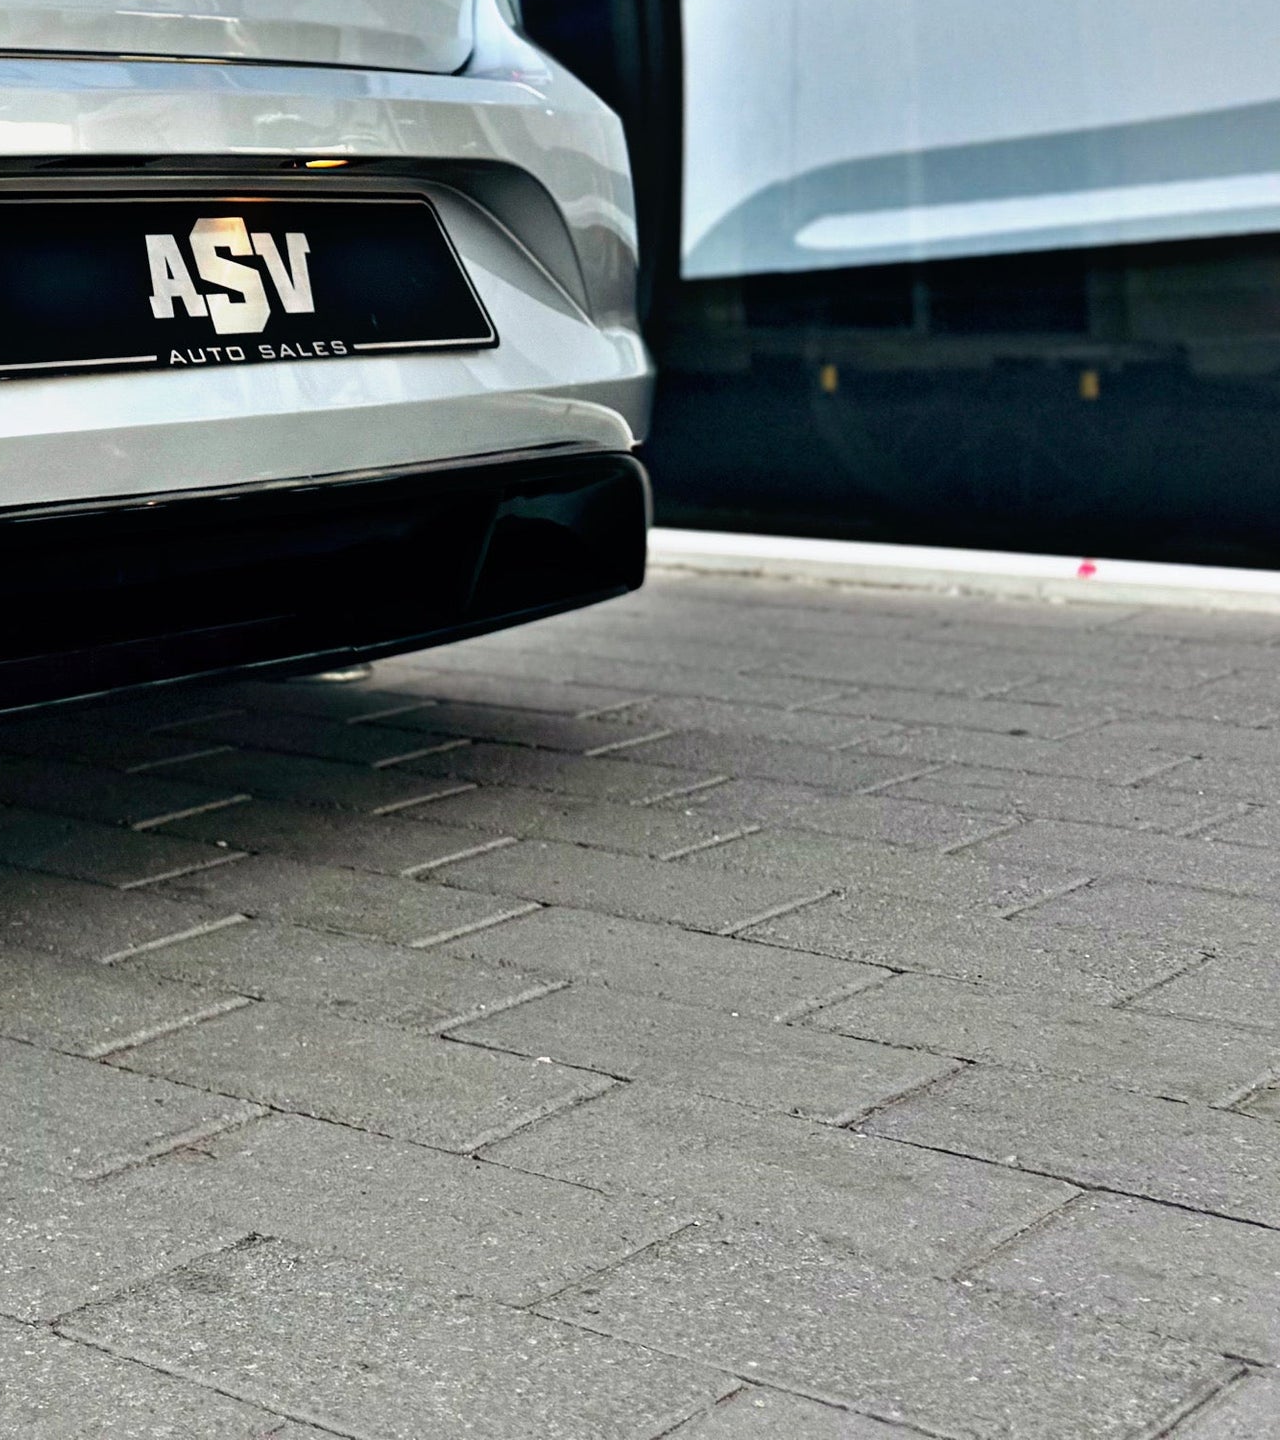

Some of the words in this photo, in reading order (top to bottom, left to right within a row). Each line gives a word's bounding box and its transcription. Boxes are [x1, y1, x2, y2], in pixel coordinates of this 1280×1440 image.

[145, 216, 315, 335] ASV
[169, 345, 246, 365] AUTO
[259, 340, 349, 361] SALES
